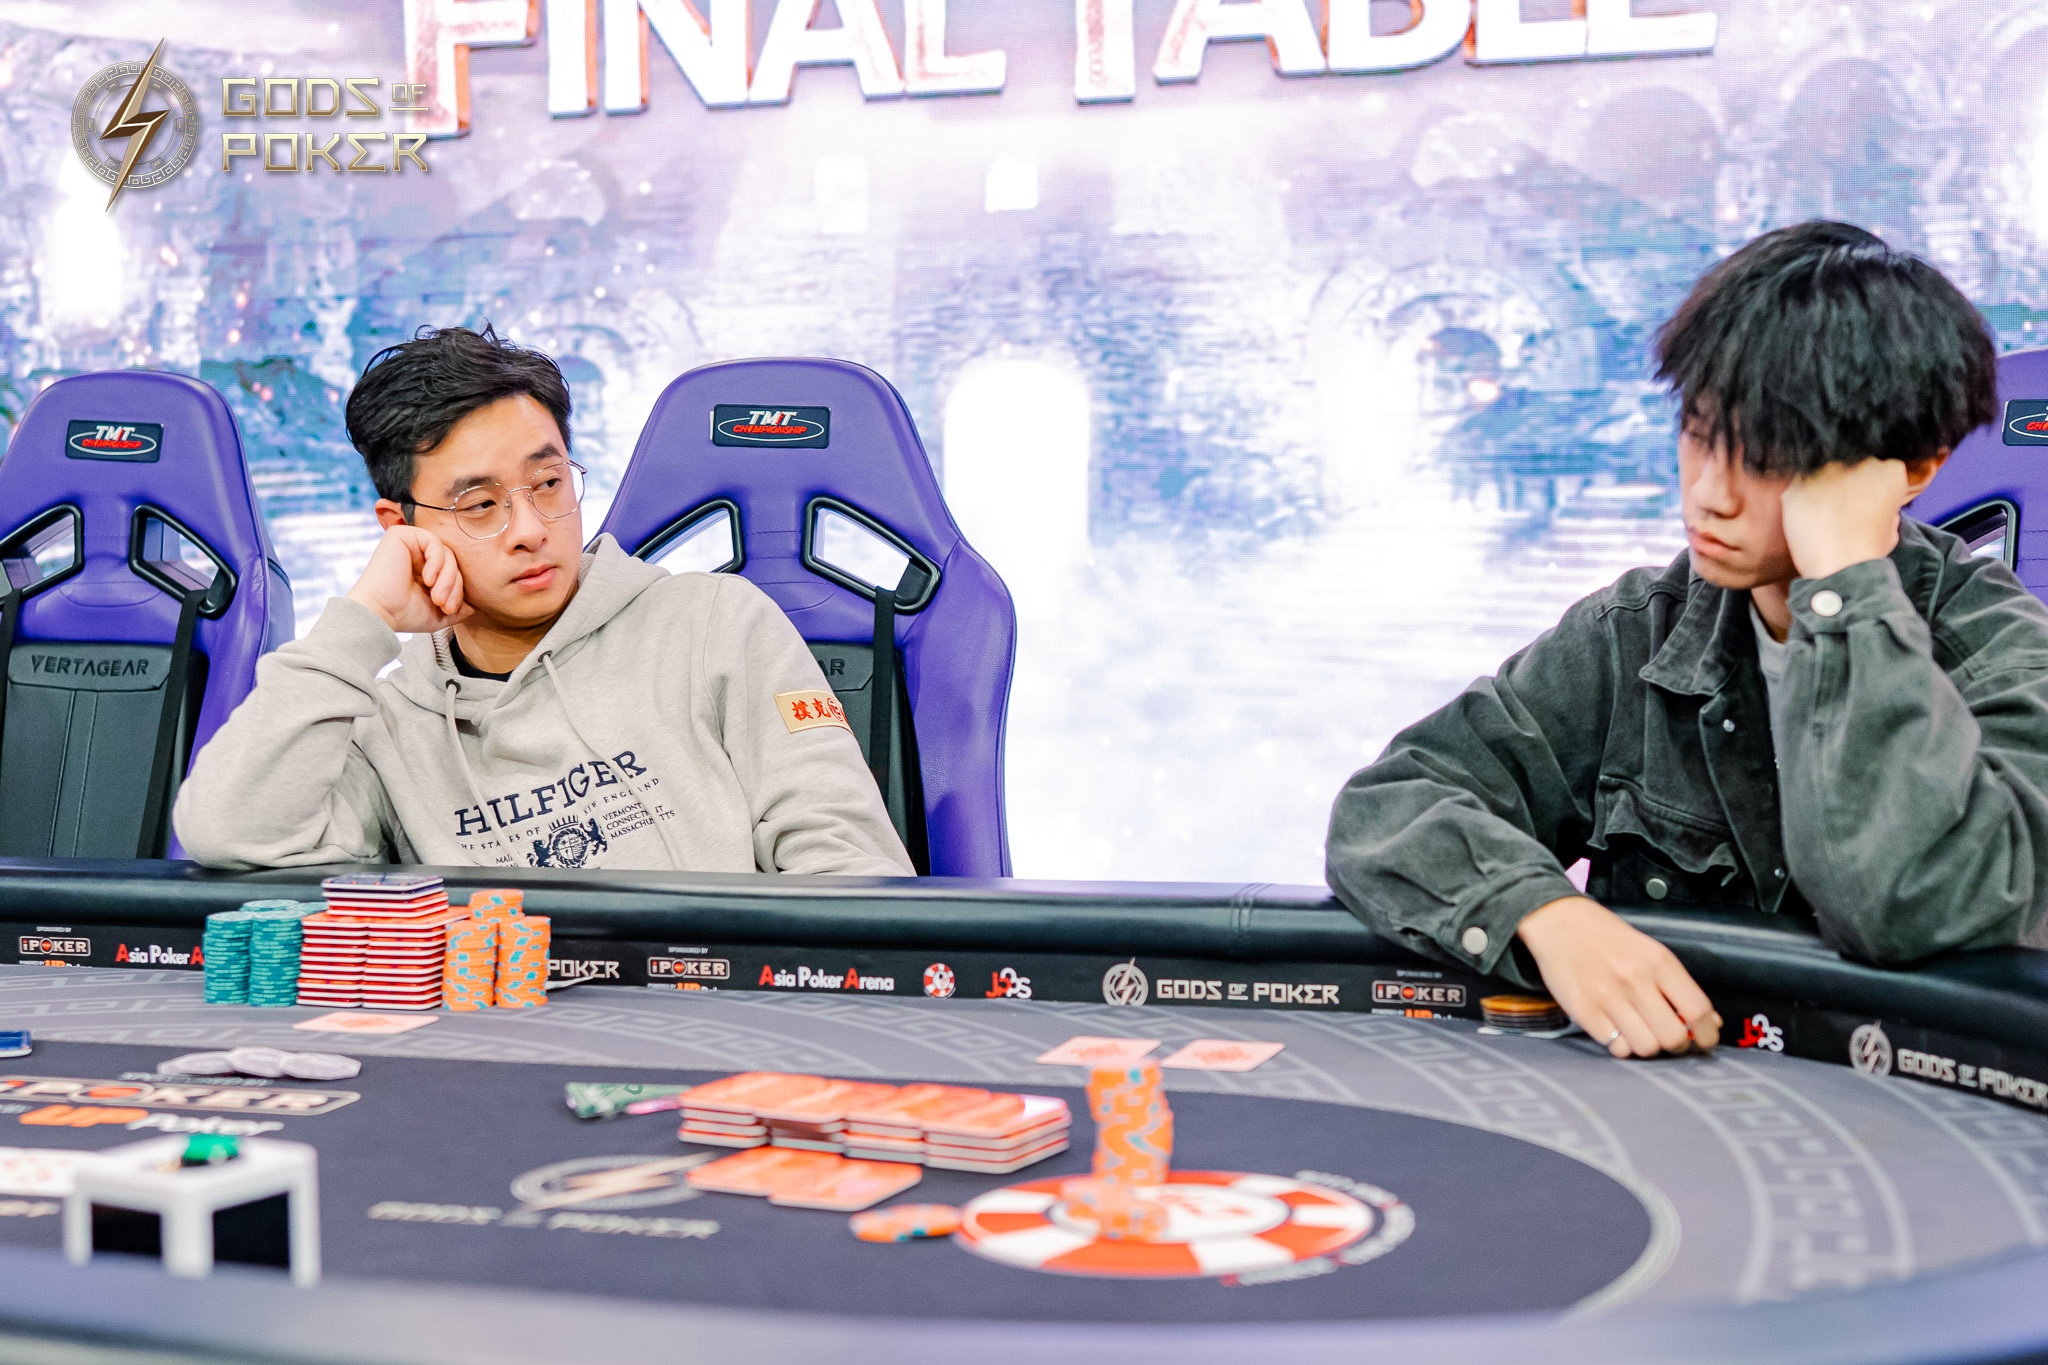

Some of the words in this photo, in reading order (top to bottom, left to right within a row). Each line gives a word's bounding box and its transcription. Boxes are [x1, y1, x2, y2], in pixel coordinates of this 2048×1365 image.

[732, 424, 808, 435] CHAMPIONSHIP
[748, 410, 798, 426] TMT
[95, 425, 136, 441] TMT
[31, 654, 149, 677] VERTAGEAR
[454, 750, 647, 837] HILFIGER
[603, 777, 659, 804] ENGLND
[602, 802, 642, 821] VERMONT
[481, 832, 521, 850] STAES
[526, 826, 541, 837] OF
[115, 943, 149, 964] Asia
[149, 944, 191, 965] Poker
[549, 959, 620, 979] POKER
[758, 965, 796, 987] Asia
[797, 966, 844, 989] Poker
[844, 968, 895, 991] Arena
[1156, 979, 1222, 1000] GODS
[1228, 983, 1248, 999] OF
[1253, 982, 1340, 1005] POKER
[1897, 1048, 1956, 1083] GODS
